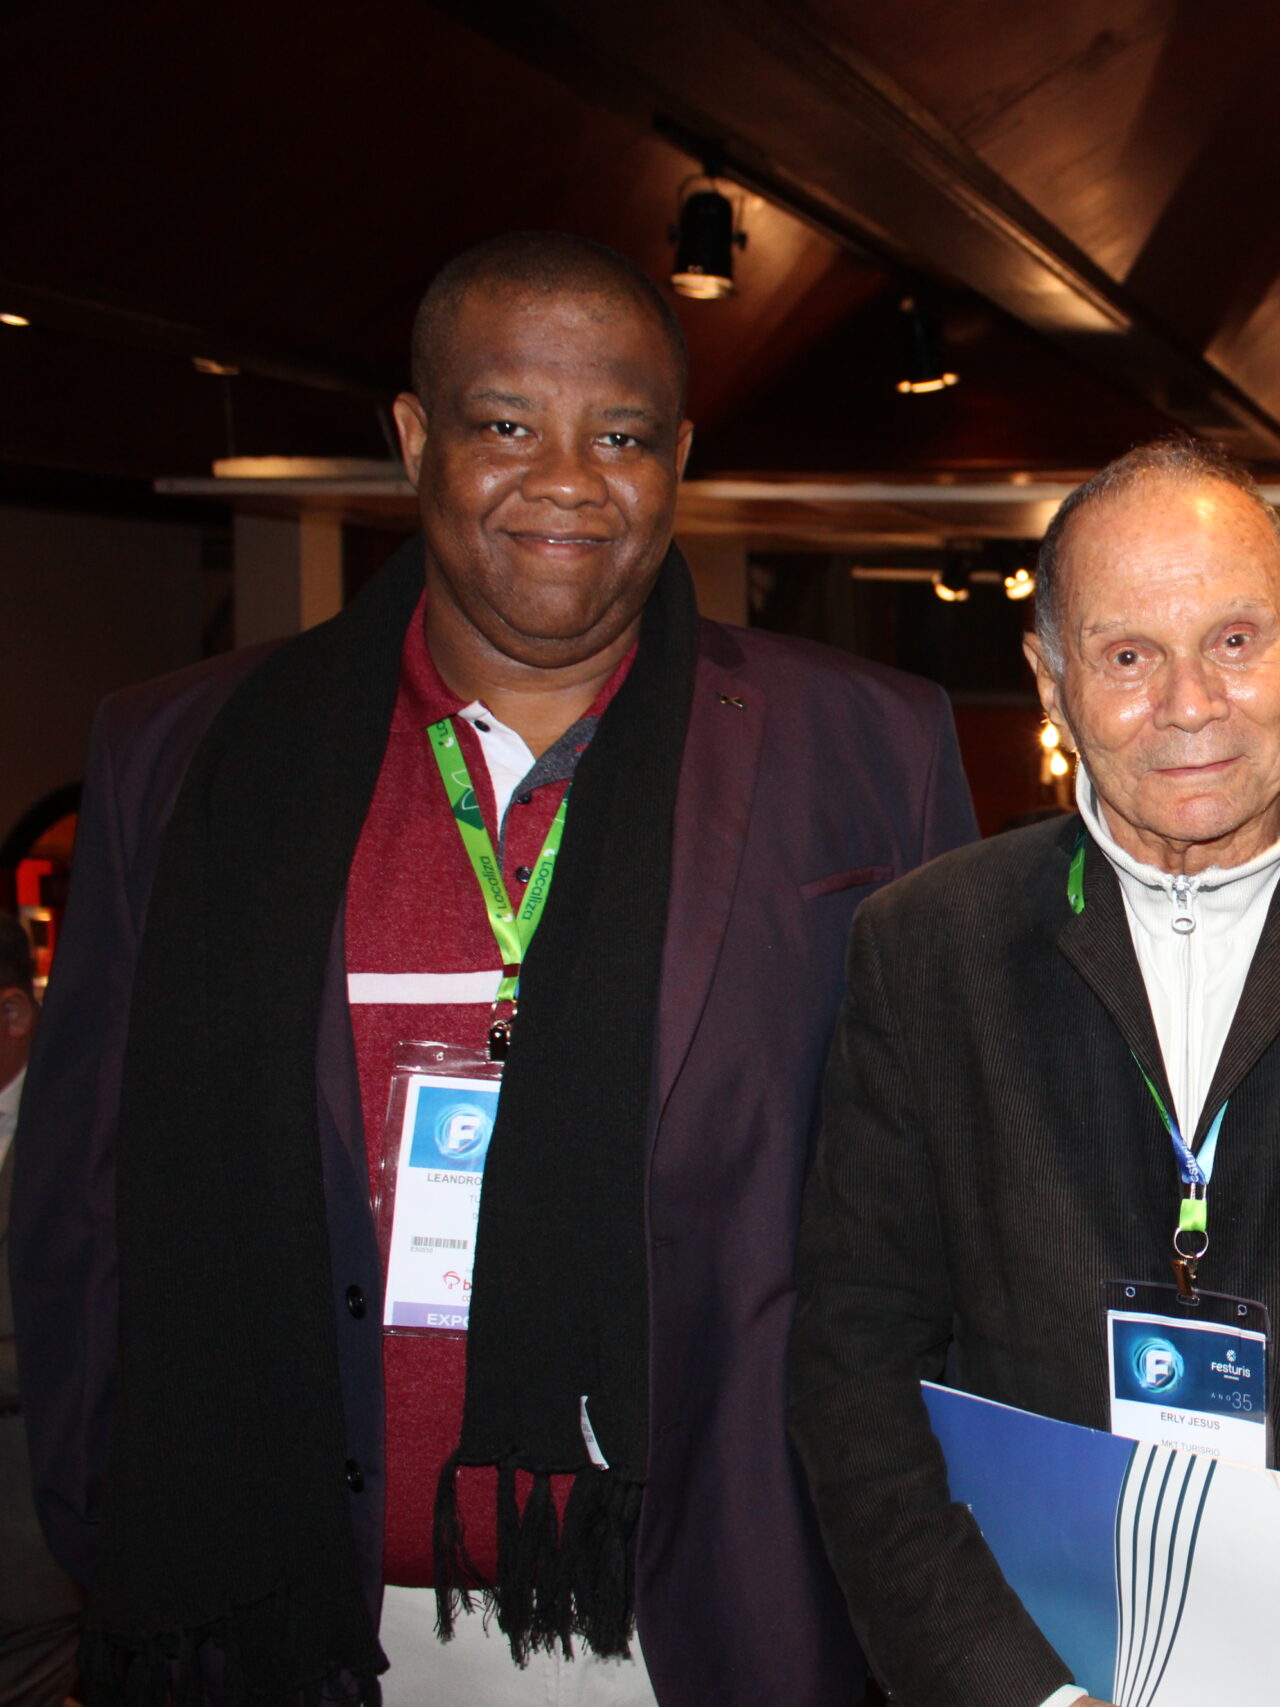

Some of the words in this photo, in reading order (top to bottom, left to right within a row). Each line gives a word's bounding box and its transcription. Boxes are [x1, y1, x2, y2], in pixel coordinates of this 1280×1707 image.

[480, 856, 508, 910] Localiza
[521, 861, 553, 920] Localiza
[427, 1172, 482, 1186] LEANDRO
[1211, 1361, 1251, 1378] Festuris
[1232, 1391, 1253, 1411] 35
[1160, 1411, 1185, 1424] ERLY
[1188, 1416, 1221, 1430] JESUS
